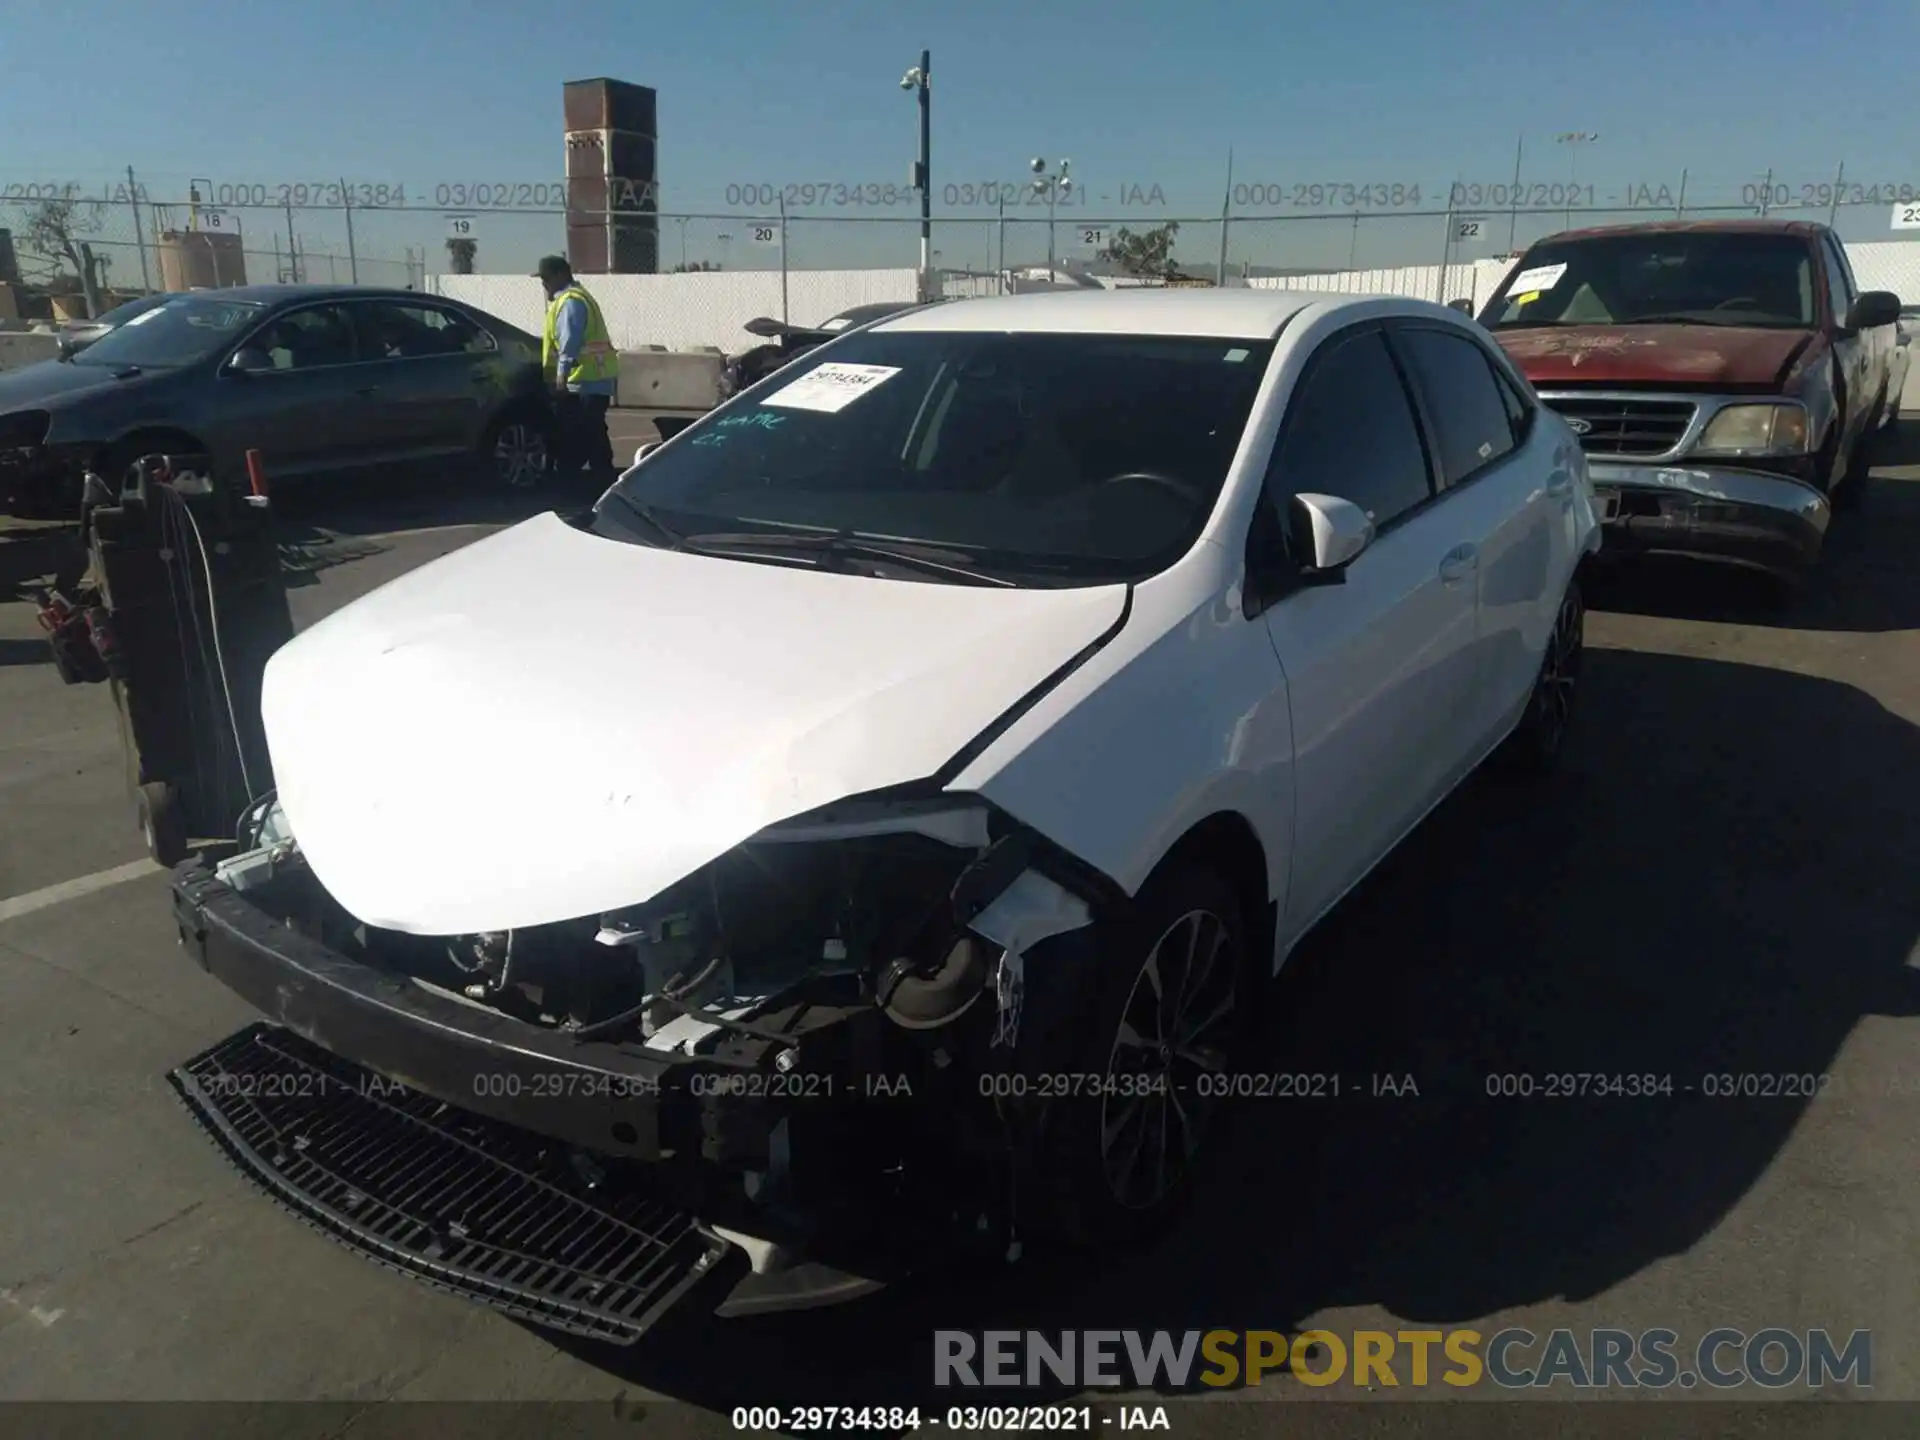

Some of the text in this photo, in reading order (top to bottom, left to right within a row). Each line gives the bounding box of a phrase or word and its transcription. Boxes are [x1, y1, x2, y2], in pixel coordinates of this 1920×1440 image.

[453, 221, 470, 233] 19
[1460, 223, 1479, 236] 22
[755, 228, 772, 241] 20
[1084, 231, 1102, 243] 21
